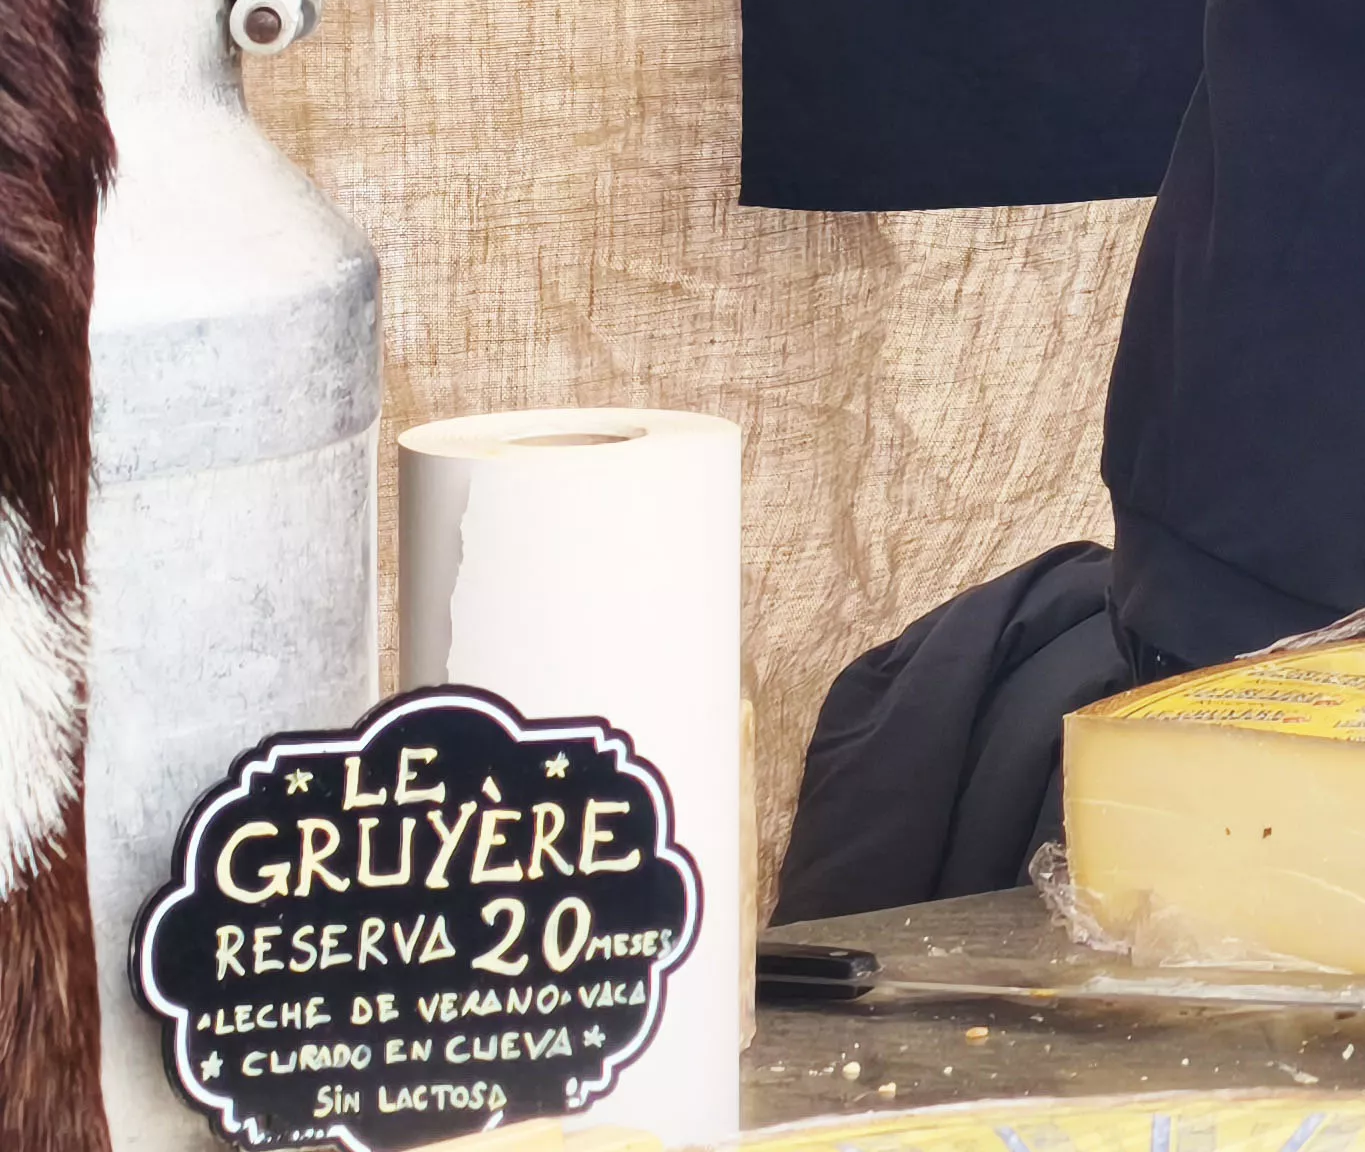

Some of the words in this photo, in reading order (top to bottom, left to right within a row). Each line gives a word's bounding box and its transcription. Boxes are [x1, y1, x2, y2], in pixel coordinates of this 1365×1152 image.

[344, 748, 446, 811] LE
[216, 776, 641, 904] GRUYÈRE
[215, 914, 456, 981] RESERVA
[472, 897, 594, 976] 20
[584, 928, 675, 961] MESES
[215, 997, 332, 1035] LECHE
[351, 994, 399, 1023] DE
[417, 983, 560, 1024] VERANO
[578, 980, 647, 1009] VACA
[241, 1044, 372, 1077] CURADO
[386, 1037, 432, 1064] EN
[444, 1026, 573, 1064] CUEVA
[378, 1082, 508, 1113] LACTOSA
